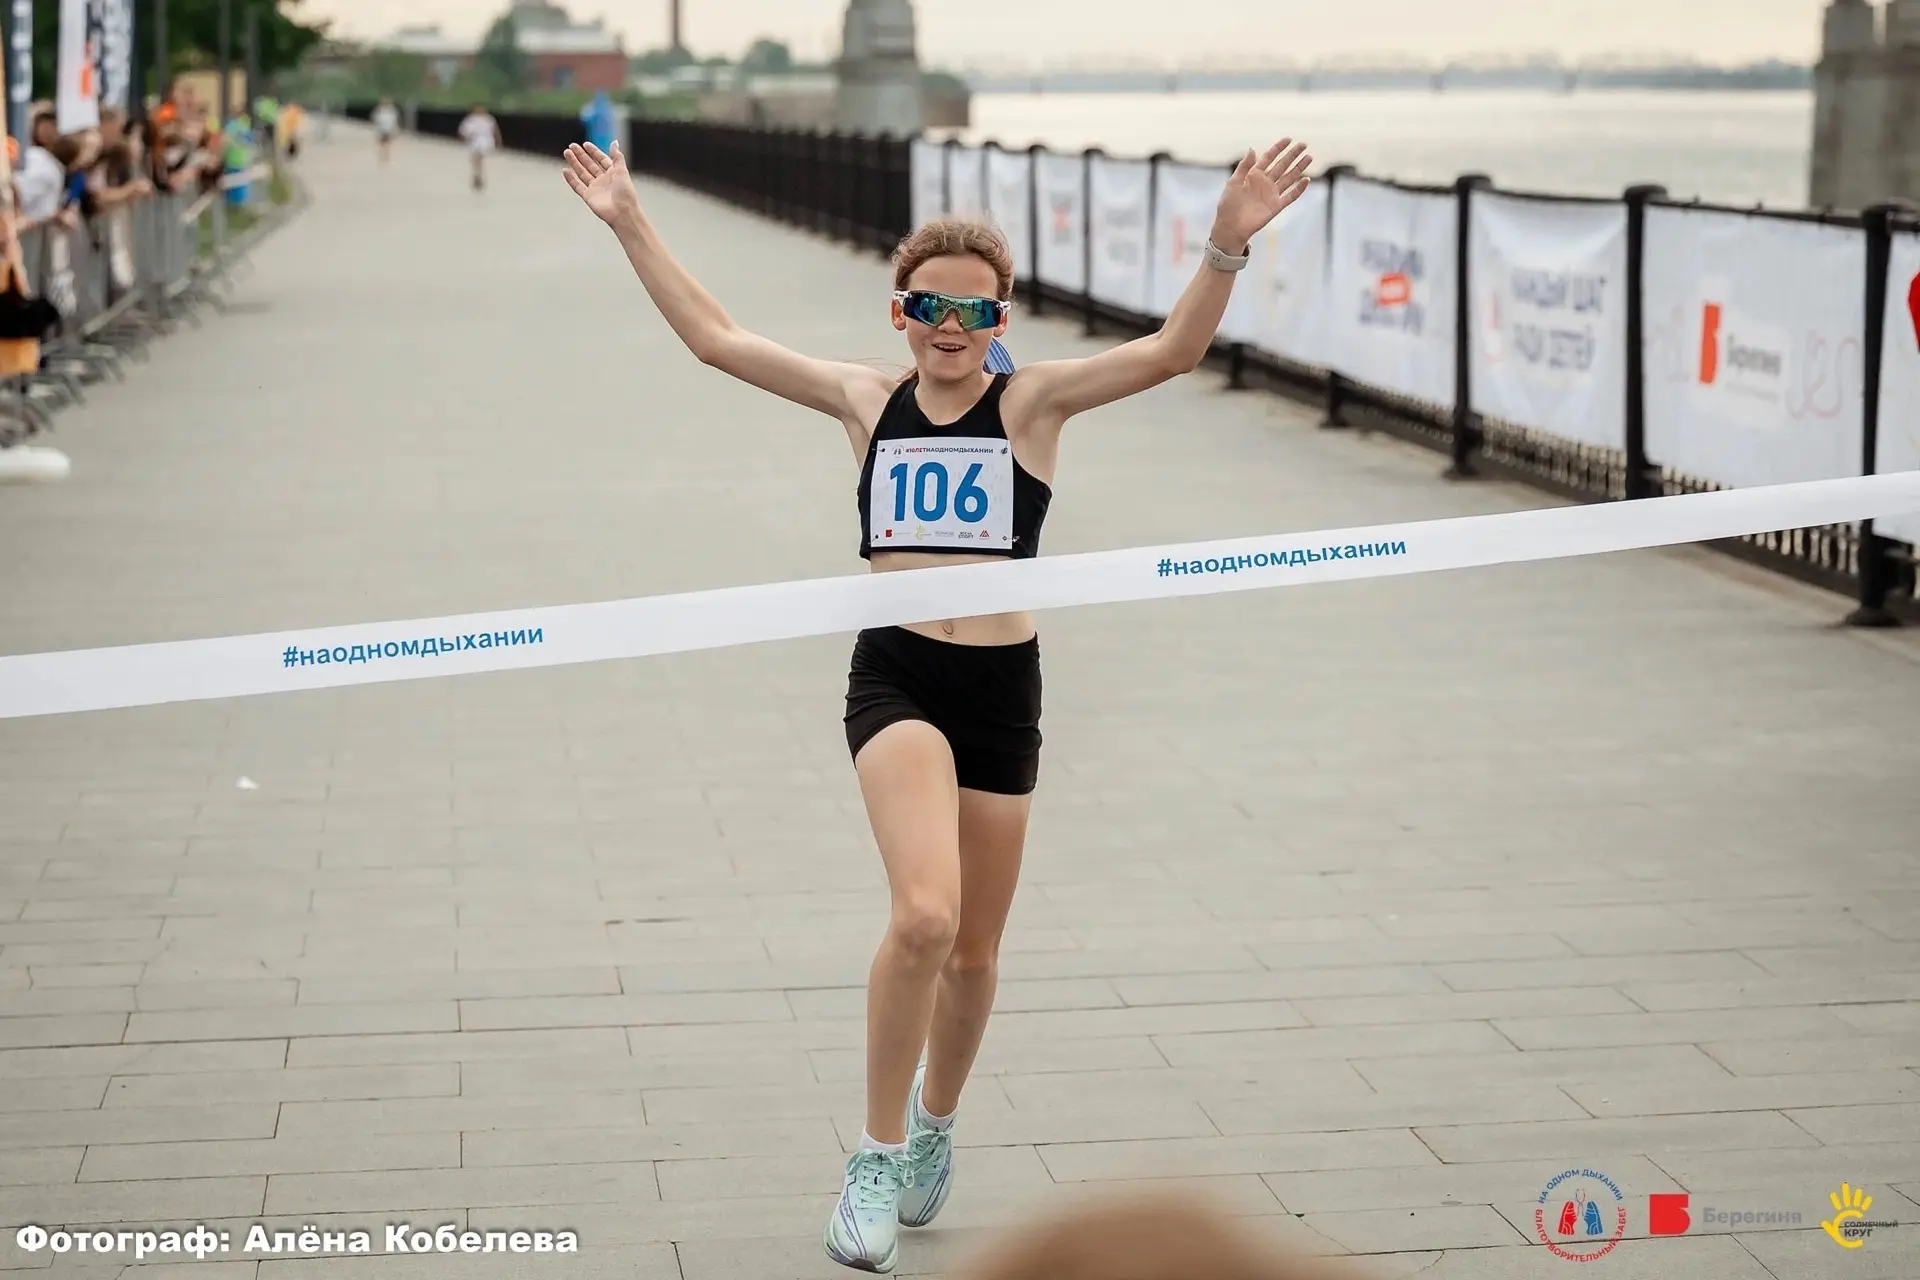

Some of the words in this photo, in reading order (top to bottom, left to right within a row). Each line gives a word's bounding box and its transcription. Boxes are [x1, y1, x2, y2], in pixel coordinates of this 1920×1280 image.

[889, 461, 989, 523] 106
[1157, 540, 1407, 578] #наодномдыхании
[282, 627, 544, 668] #наодномдыхании
